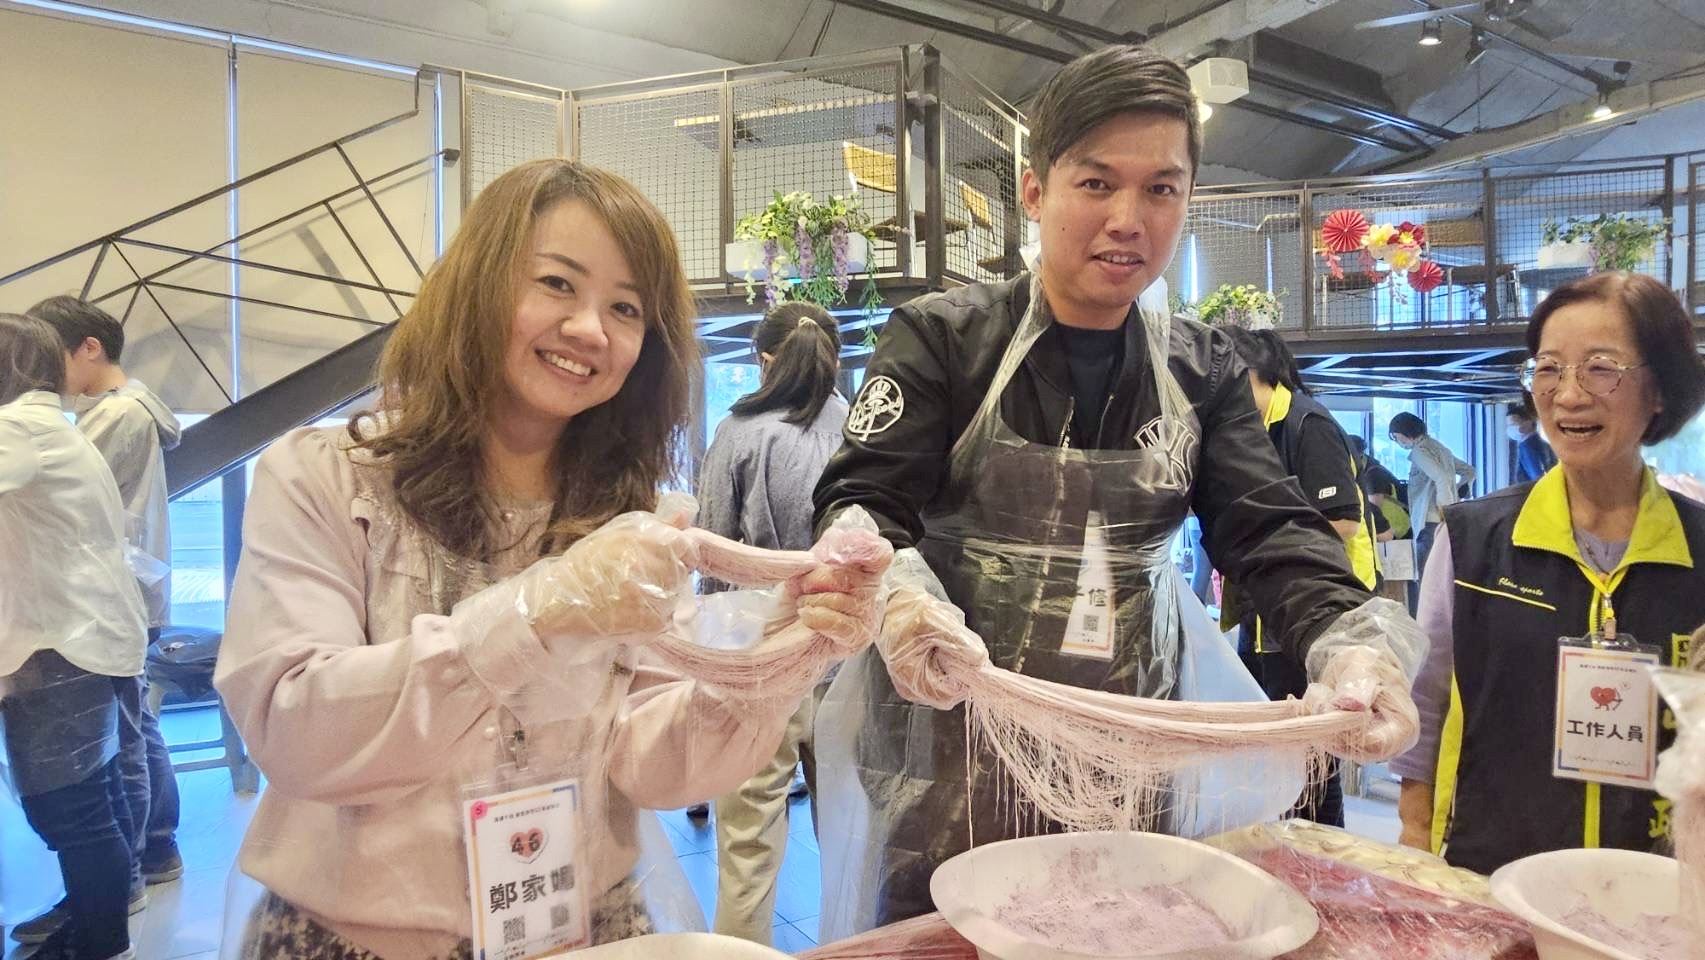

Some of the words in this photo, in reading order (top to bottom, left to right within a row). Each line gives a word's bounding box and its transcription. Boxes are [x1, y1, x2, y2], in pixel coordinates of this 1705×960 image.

[1566, 719, 1644, 743] 工作人員
[511, 832, 541, 855] 46
